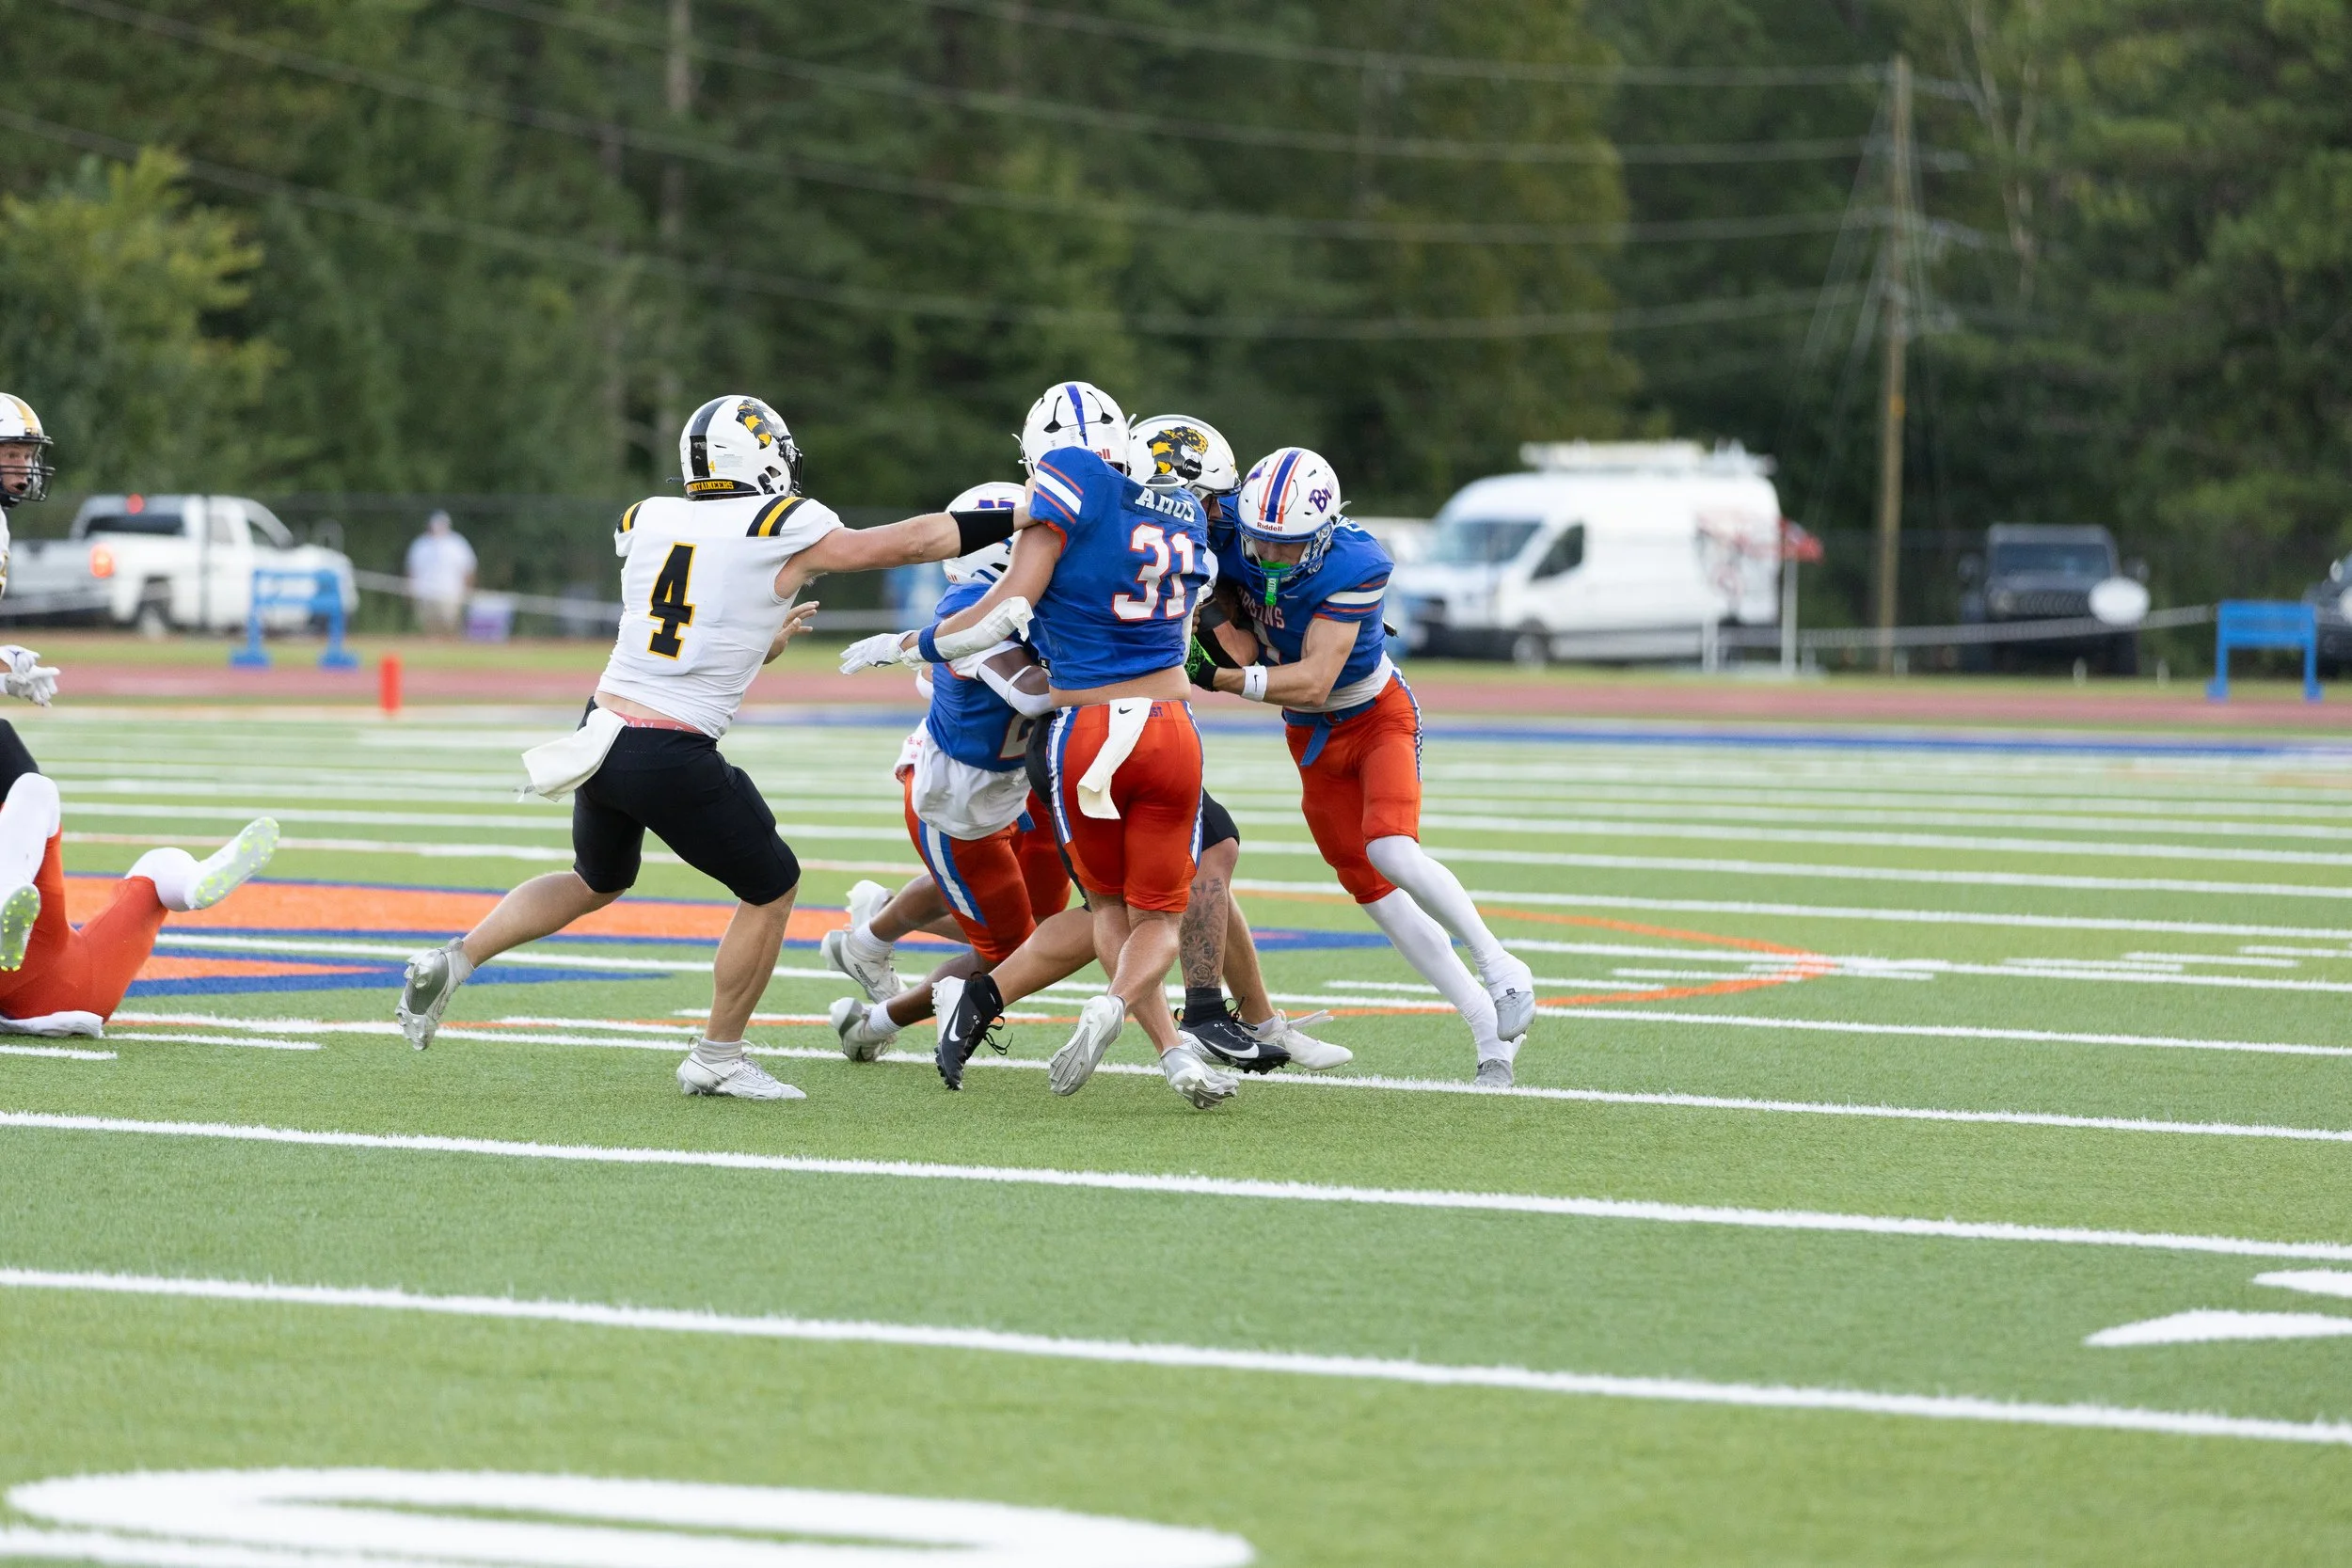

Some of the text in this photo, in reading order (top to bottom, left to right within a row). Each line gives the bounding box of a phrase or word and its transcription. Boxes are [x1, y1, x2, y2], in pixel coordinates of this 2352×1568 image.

[1135, 487, 1195, 523] AMOS
[1257, 521, 1283, 532] Riddell
[647, 542, 696, 660] 4
[1112, 522, 1194, 622] 31
